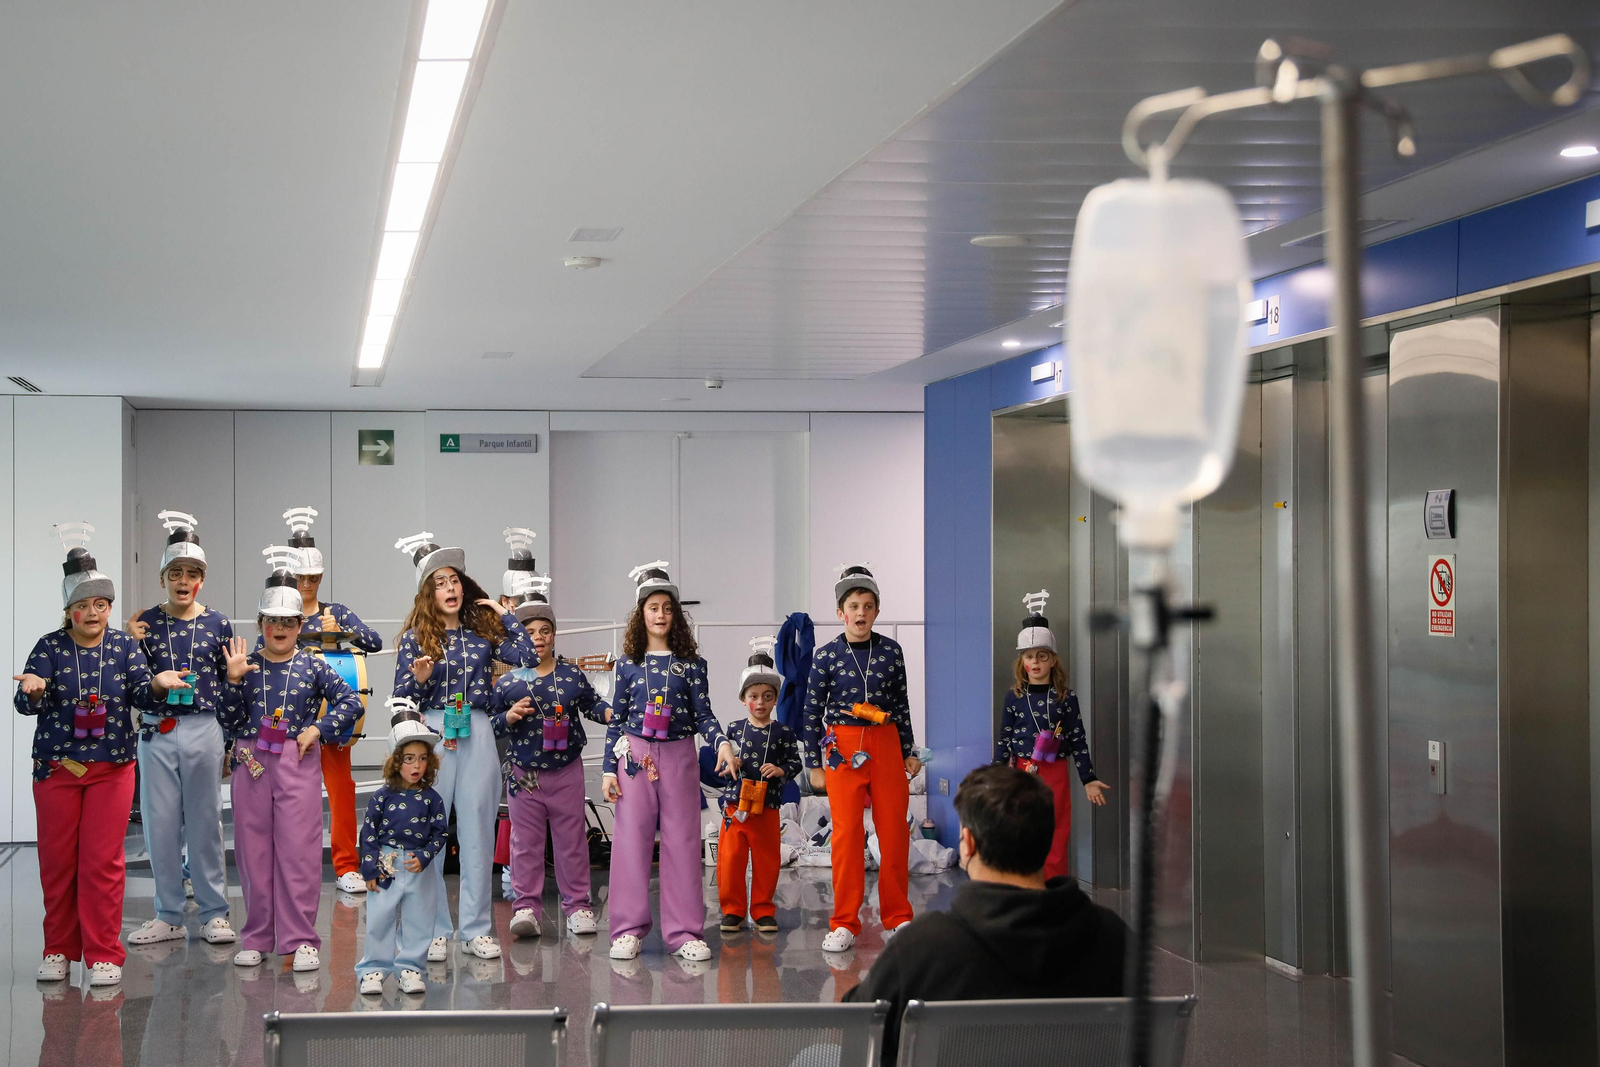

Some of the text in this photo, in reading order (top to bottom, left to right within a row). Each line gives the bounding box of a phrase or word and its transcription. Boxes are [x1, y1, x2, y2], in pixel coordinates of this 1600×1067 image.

[1269, 306, 1279, 324] 18
[1056, 370, 1062, 383] 17
[479, 439, 532, 449] Parque Infantil
